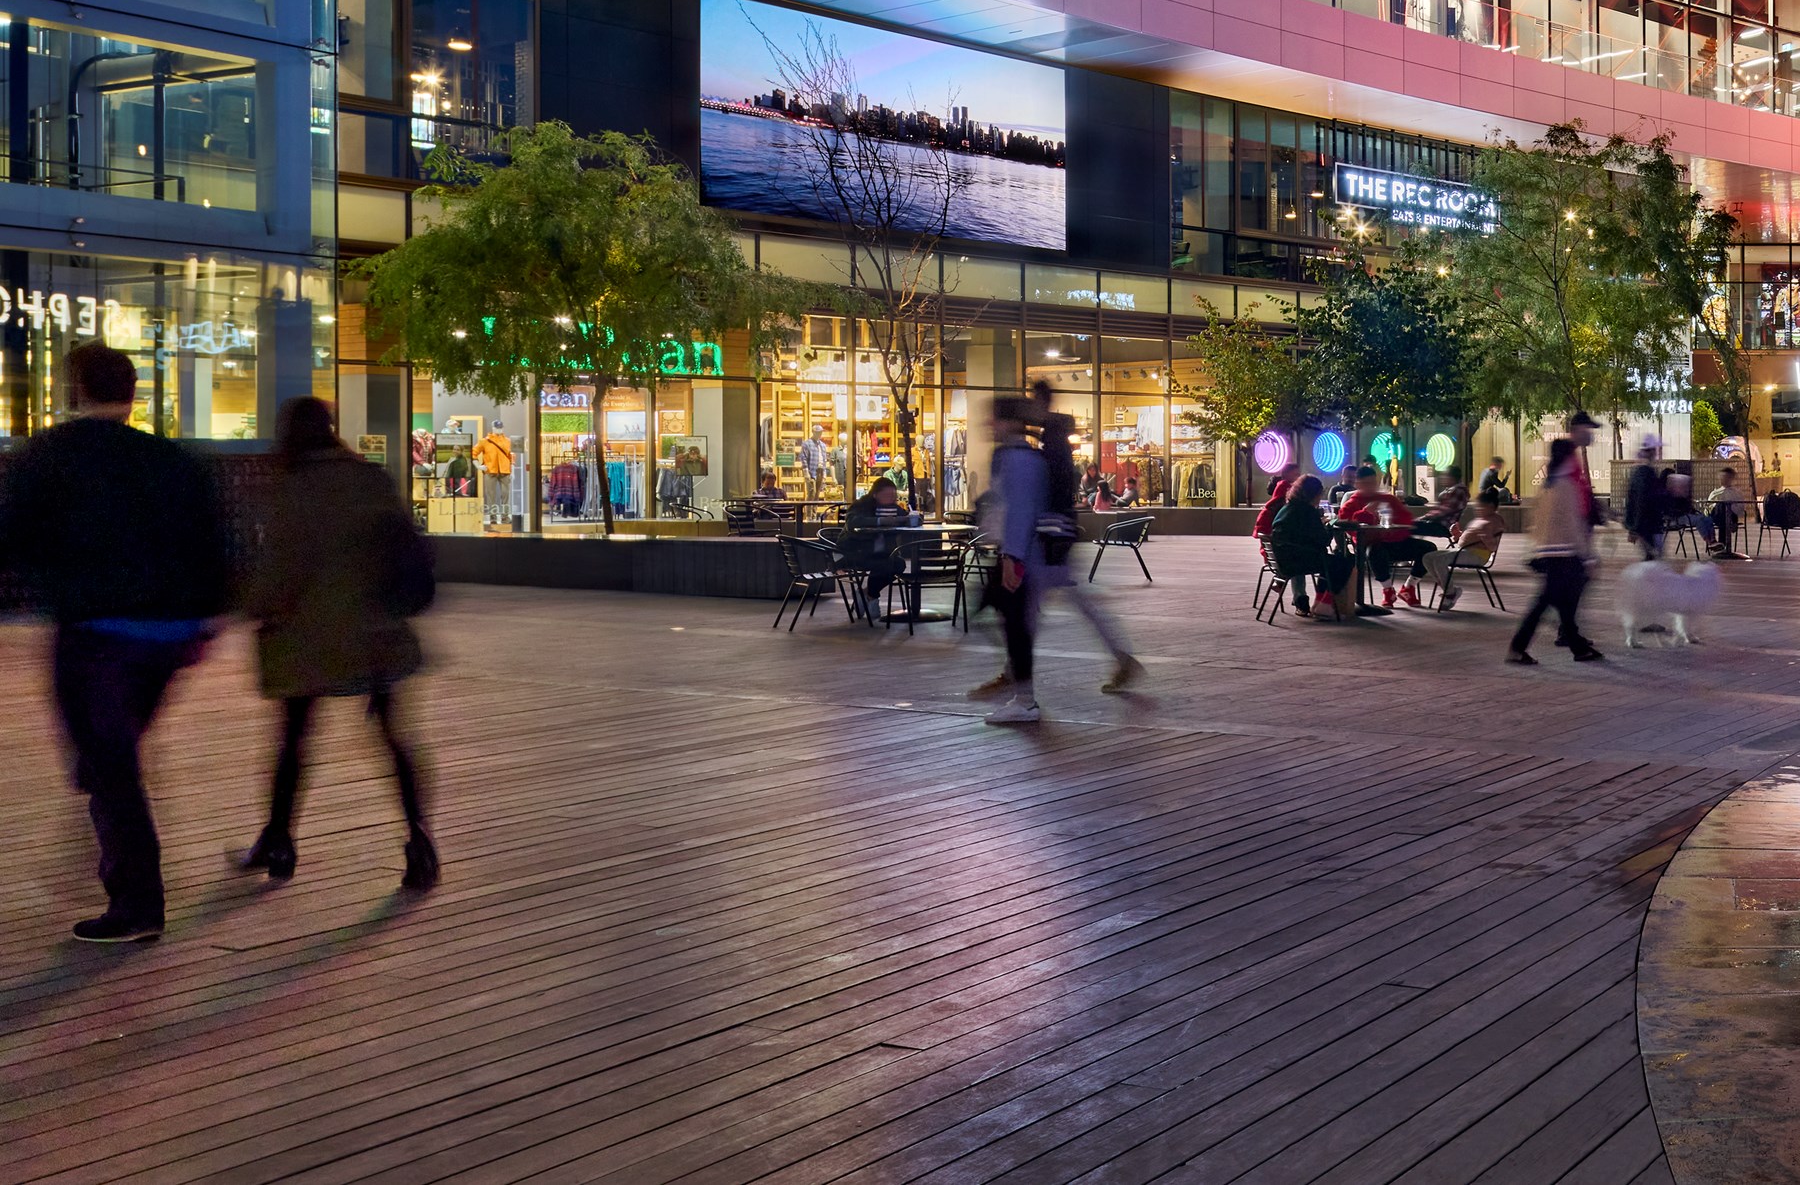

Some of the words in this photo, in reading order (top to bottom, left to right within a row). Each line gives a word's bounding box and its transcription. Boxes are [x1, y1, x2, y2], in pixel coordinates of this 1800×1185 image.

[1345, 173, 1387, 201] THE
[1391, 180, 1432, 207] REC
[1435, 187, 1496, 218] ROOM
[1392, 209, 1414, 223] EATS
